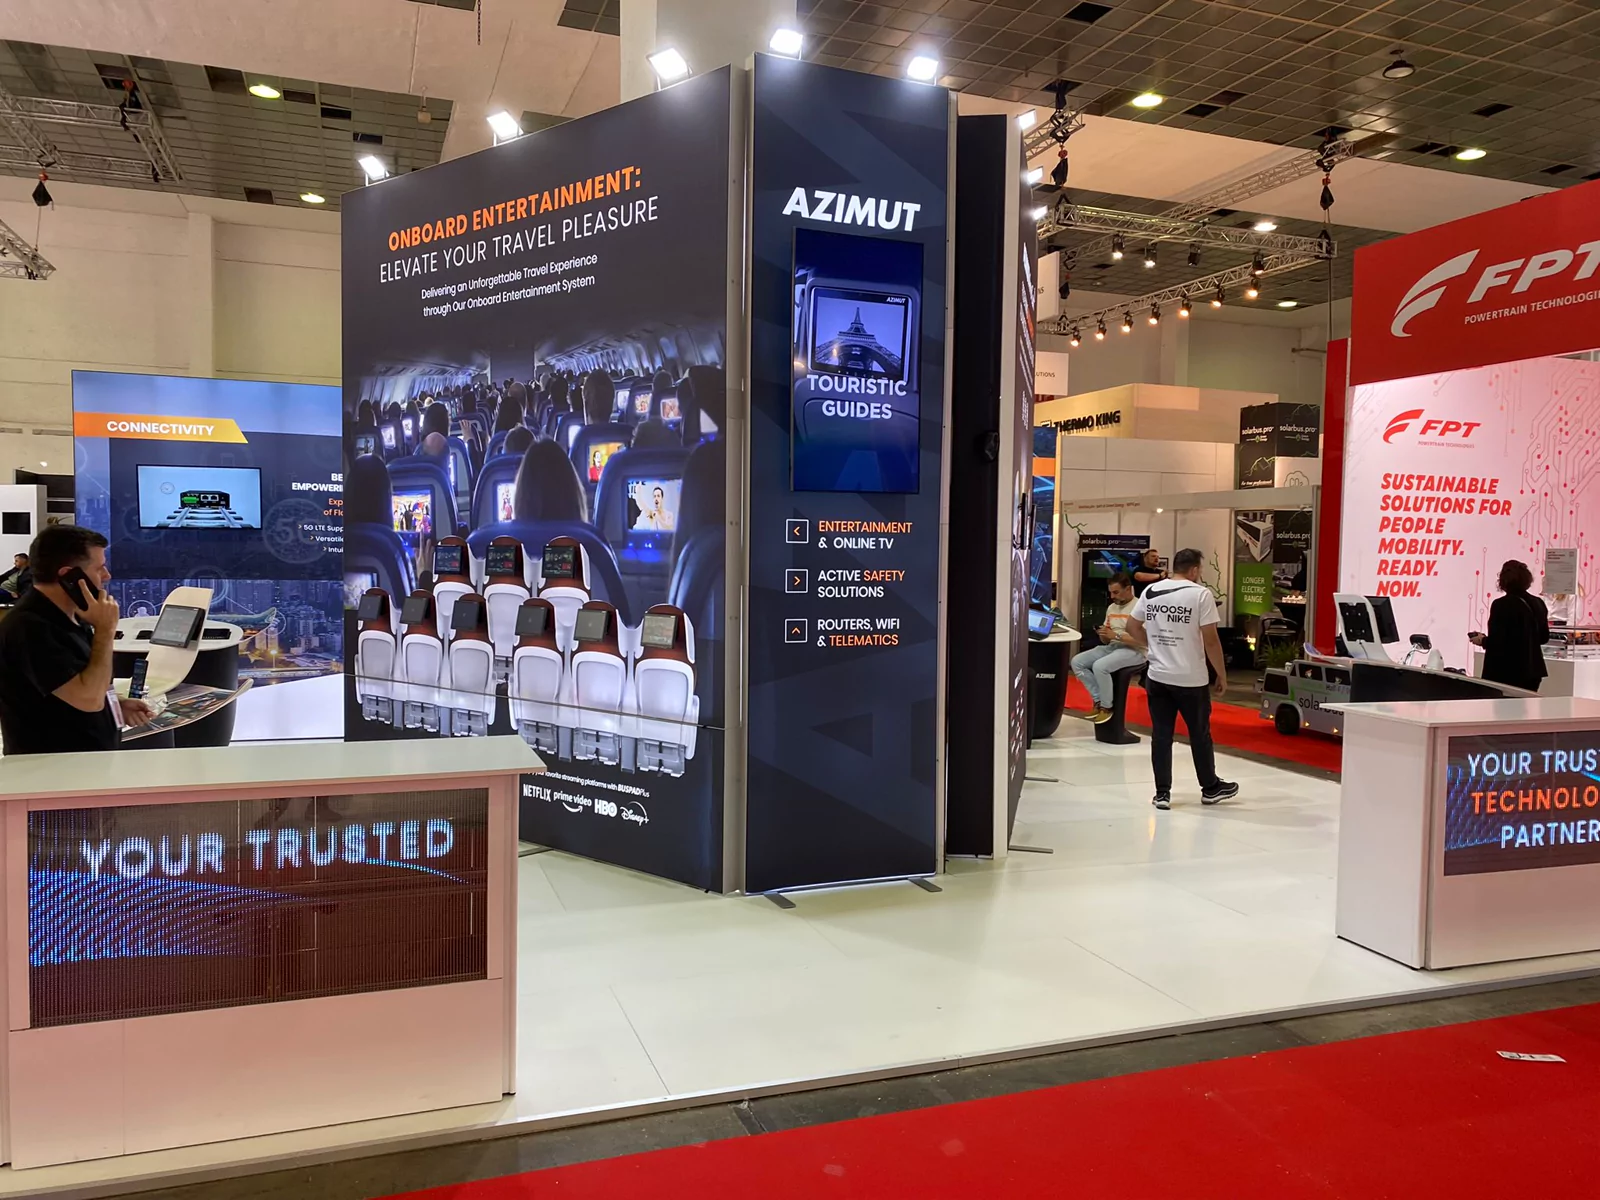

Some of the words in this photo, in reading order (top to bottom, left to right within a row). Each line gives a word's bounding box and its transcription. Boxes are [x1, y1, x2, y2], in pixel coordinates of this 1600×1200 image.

[388, 214, 467, 252] ONBOARD
[472, 166, 642, 231] ENTERTAINMENT:
[782, 186, 921, 232] AZIMUT
[380, 251, 438, 283] ELEVATE
[443, 240, 487, 269] YOUR
[492, 223, 556, 258] TRAVEL
[562, 196, 659, 242] PLEASURE
[421, 282, 456, 299] Delivering
[457, 282, 468, 292] an
[468, 269, 522, 290] Unforgettable
[523, 263, 549, 279] Travel
[549, 254, 598, 274] Experience
[1466, 240, 1600, 304] FPT
[423, 302, 452, 317] through
[452, 300, 466, 312] Our
[467, 292, 502, 310] Onboard
[502, 282, 561, 303] Entertainment
[562, 275, 595, 293] System
[886, 296, 906, 304] AZIMUT
[1464, 304, 1528, 325] POWERTRAIN
[807, 374, 907, 397] TOURISTIC
[822, 400, 892, 419] GUIDES
[106, 420, 215, 436] CONNECTIVITY
[1053, 415, 1095, 432] THERMO
[1095, 410, 1121, 427] KING
[1279, 424, 1315, 433] solarbus.pro
[1419, 419, 1481, 438] FPT
[1241, 426, 1272, 435] solarbus.pro
[1381, 473, 1499, 495] SUSTAINABLE
[1379, 495, 1475, 515] SOLUTIONS
[1478, 499, 1512, 516] FOR
[314, 524, 326, 532] LTE
[818, 520, 913, 534] ENTERTAINMENT
[1378, 516, 1446, 535] PEOPLE
[818, 538, 828, 549] &
[833, 537, 876, 549] ONLINE
[878, 538, 894, 549] TV
[1377, 538, 1465, 556] MOBILITY.
[817, 570, 861, 582] ACTIVE
[863, 570, 906, 582] SAFETY
[1376, 559, 1439, 577] READY.
[1241, 585, 1266, 594] ELECTRIC
[1242, 576, 1265, 585] LONGER
[1375, 580, 1422, 598] NOW.
[817, 586, 885, 598] SOLUTIONS
[1243, 595, 1263, 604] RANGE
[1146, 604, 1193, 616] SWOOSH
[1146, 613, 1157, 621] BY
[1167, 614, 1191, 624] NIKE
[817, 619, 873, 631] ROUTERS,
[875, 618, 900, 630] WIFI
[816, 635, 827, 647] &
[829, 634, 899, 647] TELEMATICS
[1467, 752, 1531, 777] YOUR
[1541, 748, 1600, 774] TRUS
[523, 783, 551, 802] NETFLIX
[606, 782, 618, 790] with
[553, 790, 573, 803] prime
[573, 794, 592, 807] video
[594, 798, 618, 817] HBO
[1471, 785, 1600, 814] TECHNOLO
[1501, 818, 1600, 849] PARTNER
[80, 831, 226, 880] YOUR
[245, 818, 455, 871] TRUSTED
